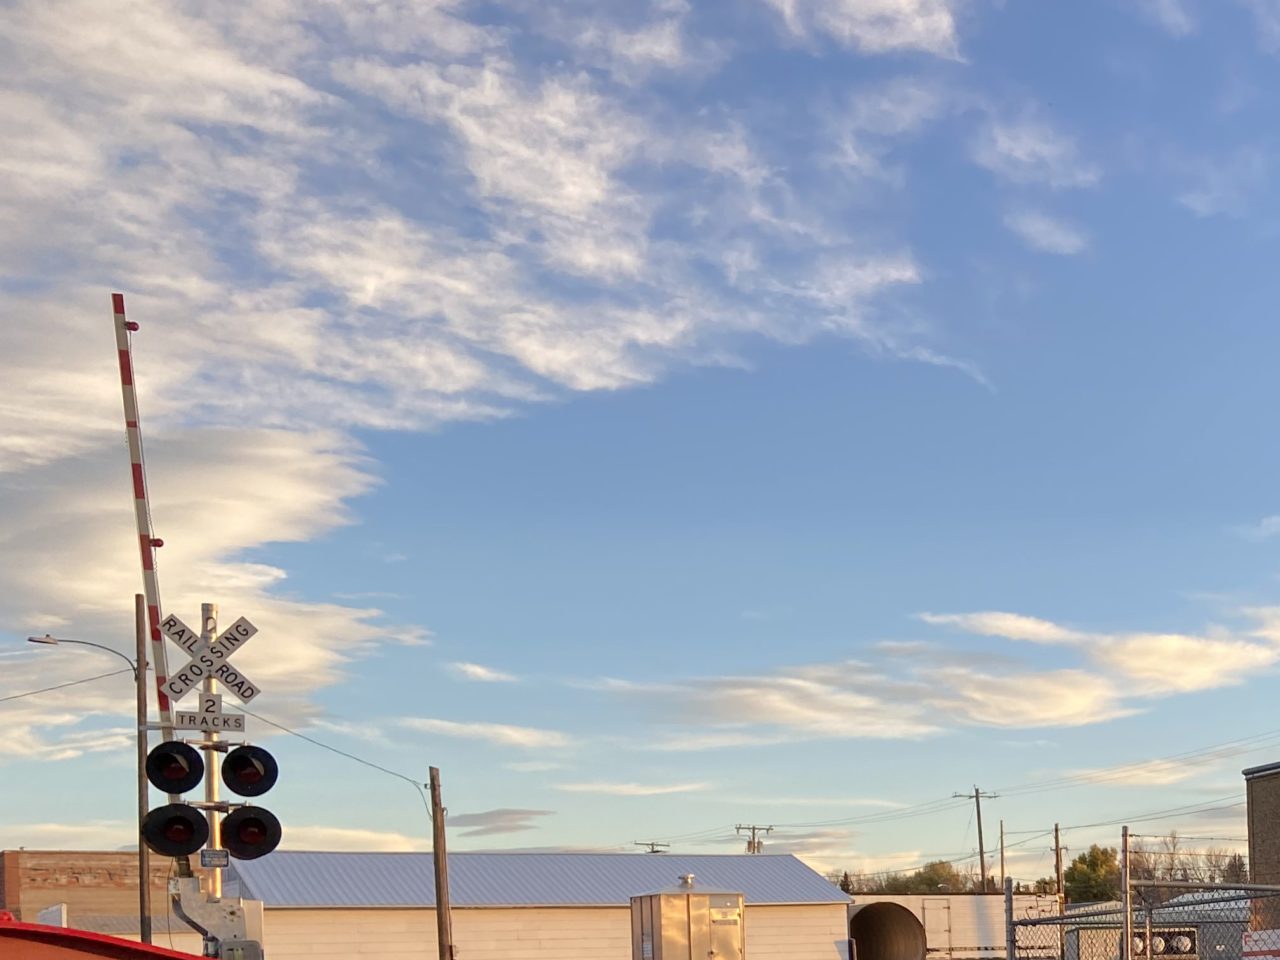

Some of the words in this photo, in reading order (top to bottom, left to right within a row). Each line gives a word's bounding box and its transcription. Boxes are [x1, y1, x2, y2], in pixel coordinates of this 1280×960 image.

[162, 618, 198, 653] RAIL
[215, 664, 254, 699] ROAD
[169, 624, 249, 695] CROSSING
[179, 715, 242, 728] TRACKS
[205, 699, 216, 713] 2
